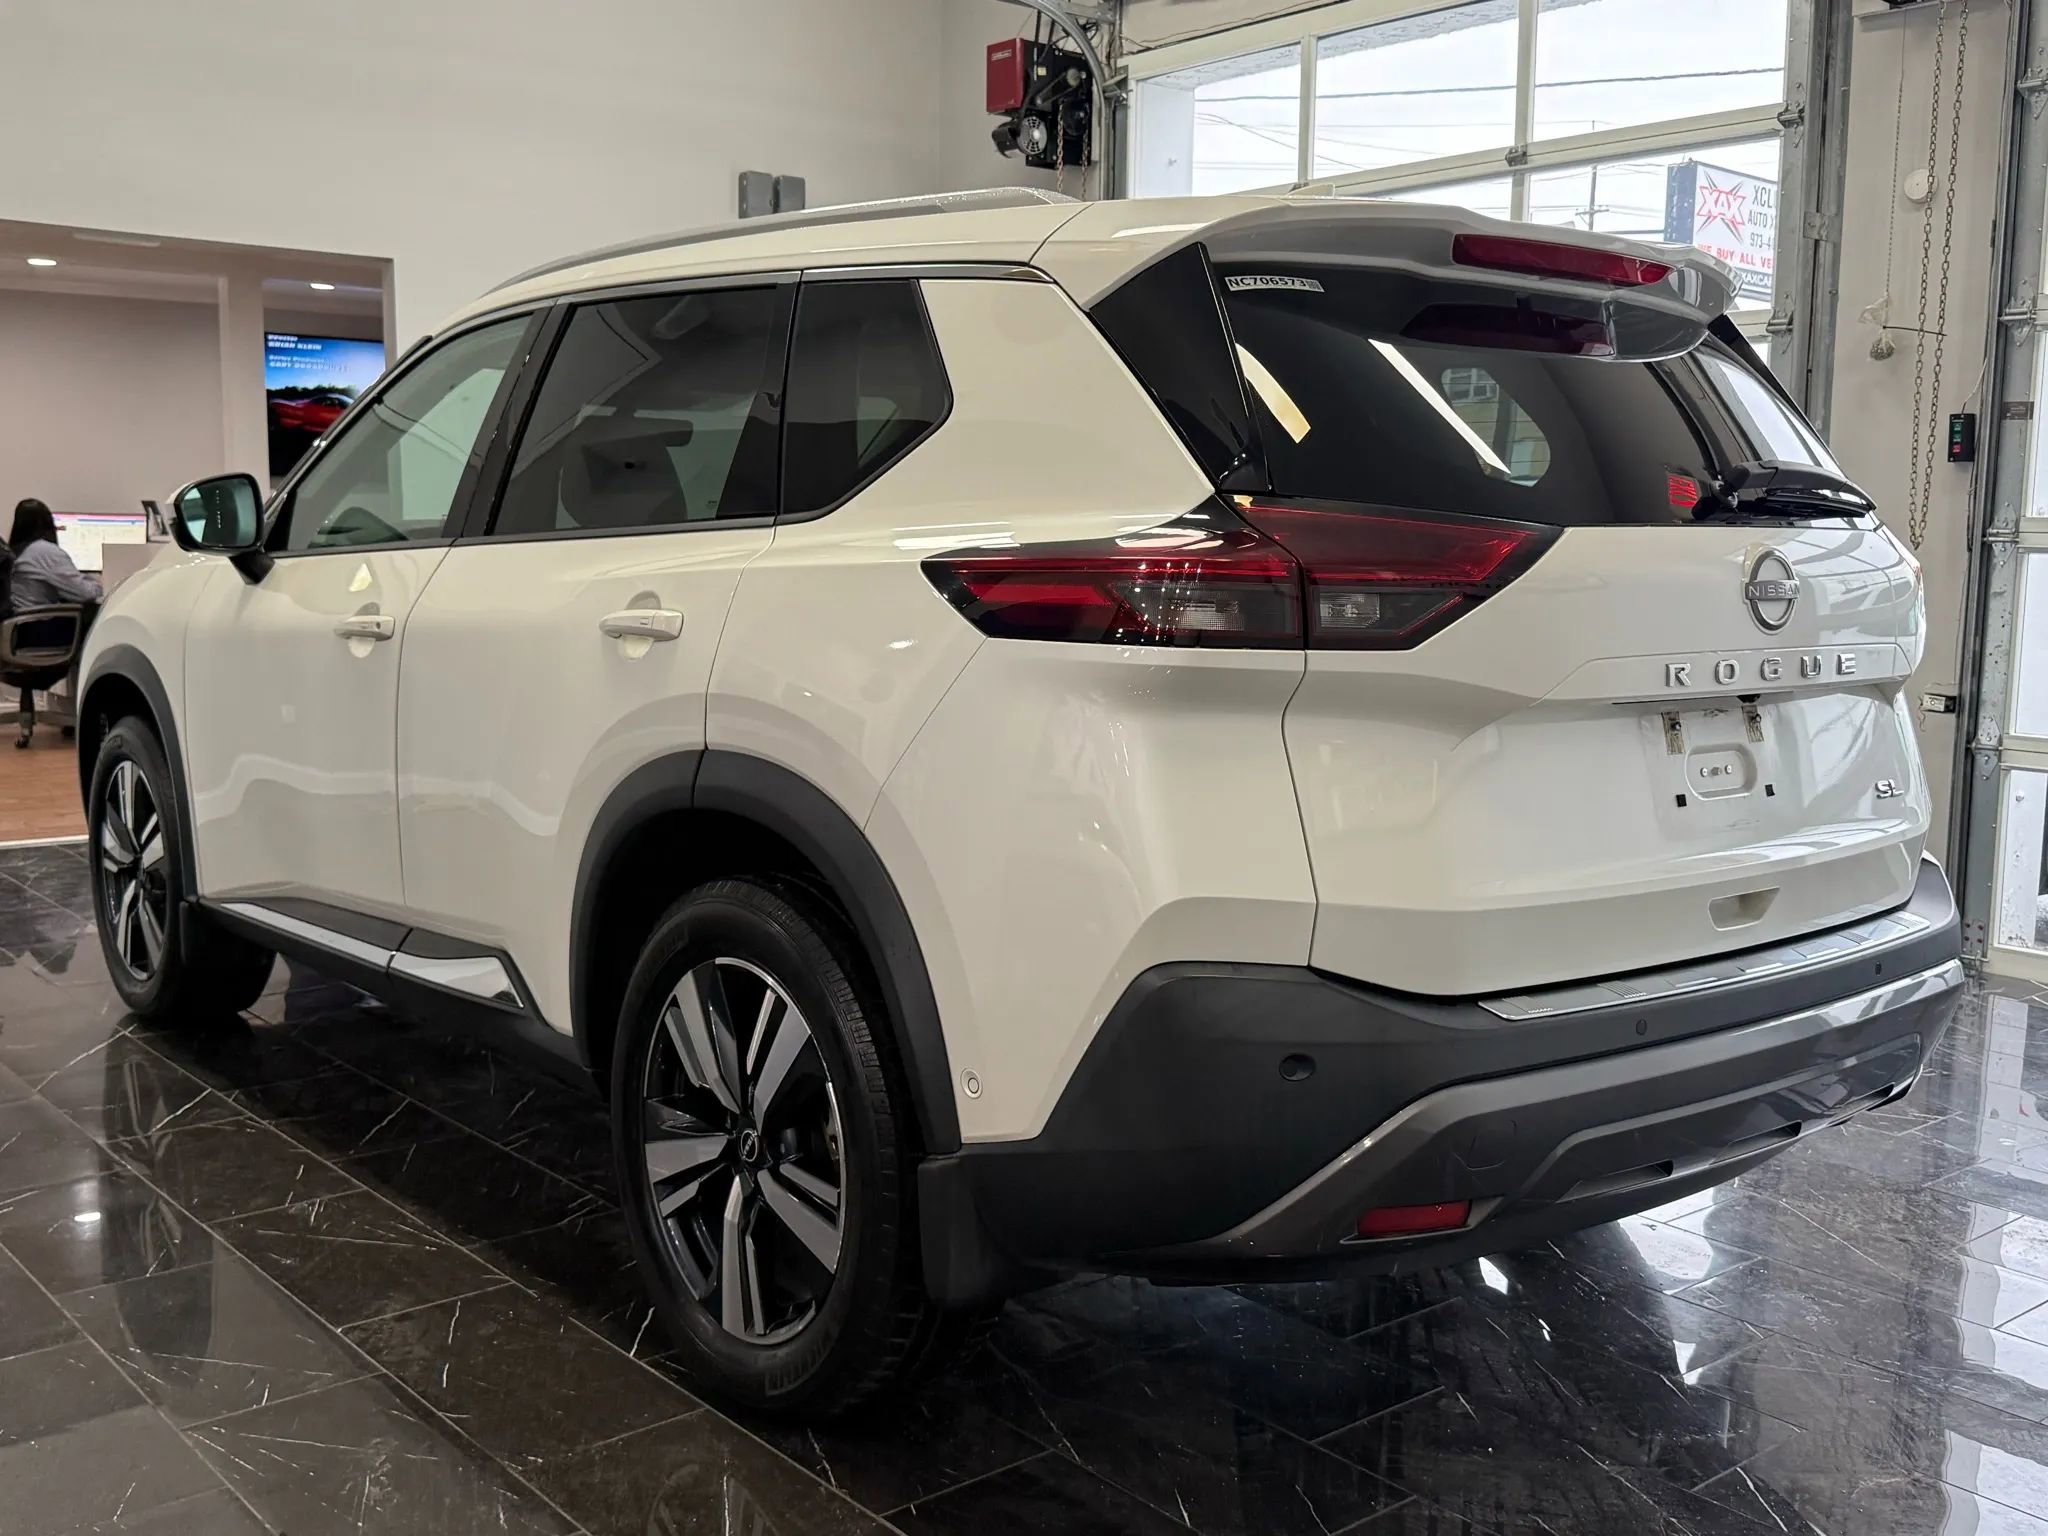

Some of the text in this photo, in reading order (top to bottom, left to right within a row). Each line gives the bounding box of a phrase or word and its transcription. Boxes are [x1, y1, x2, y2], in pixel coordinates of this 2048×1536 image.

[1748, 210, 1768, 228] AUTO
[1750, 232, 1774, 251] 973-4
[1716, 247, 1735, 262] BUY
[1739, 252, 1757, 266] ALL
[1760, 257, 1774, 270] VE
[1227, 277, 1307, 287] NC706573
[1748, 583, 1800, 597] NISSAN
[1666, 653, 1857, 687] ROGUE
[1875, 778, 1904, 799] SL
